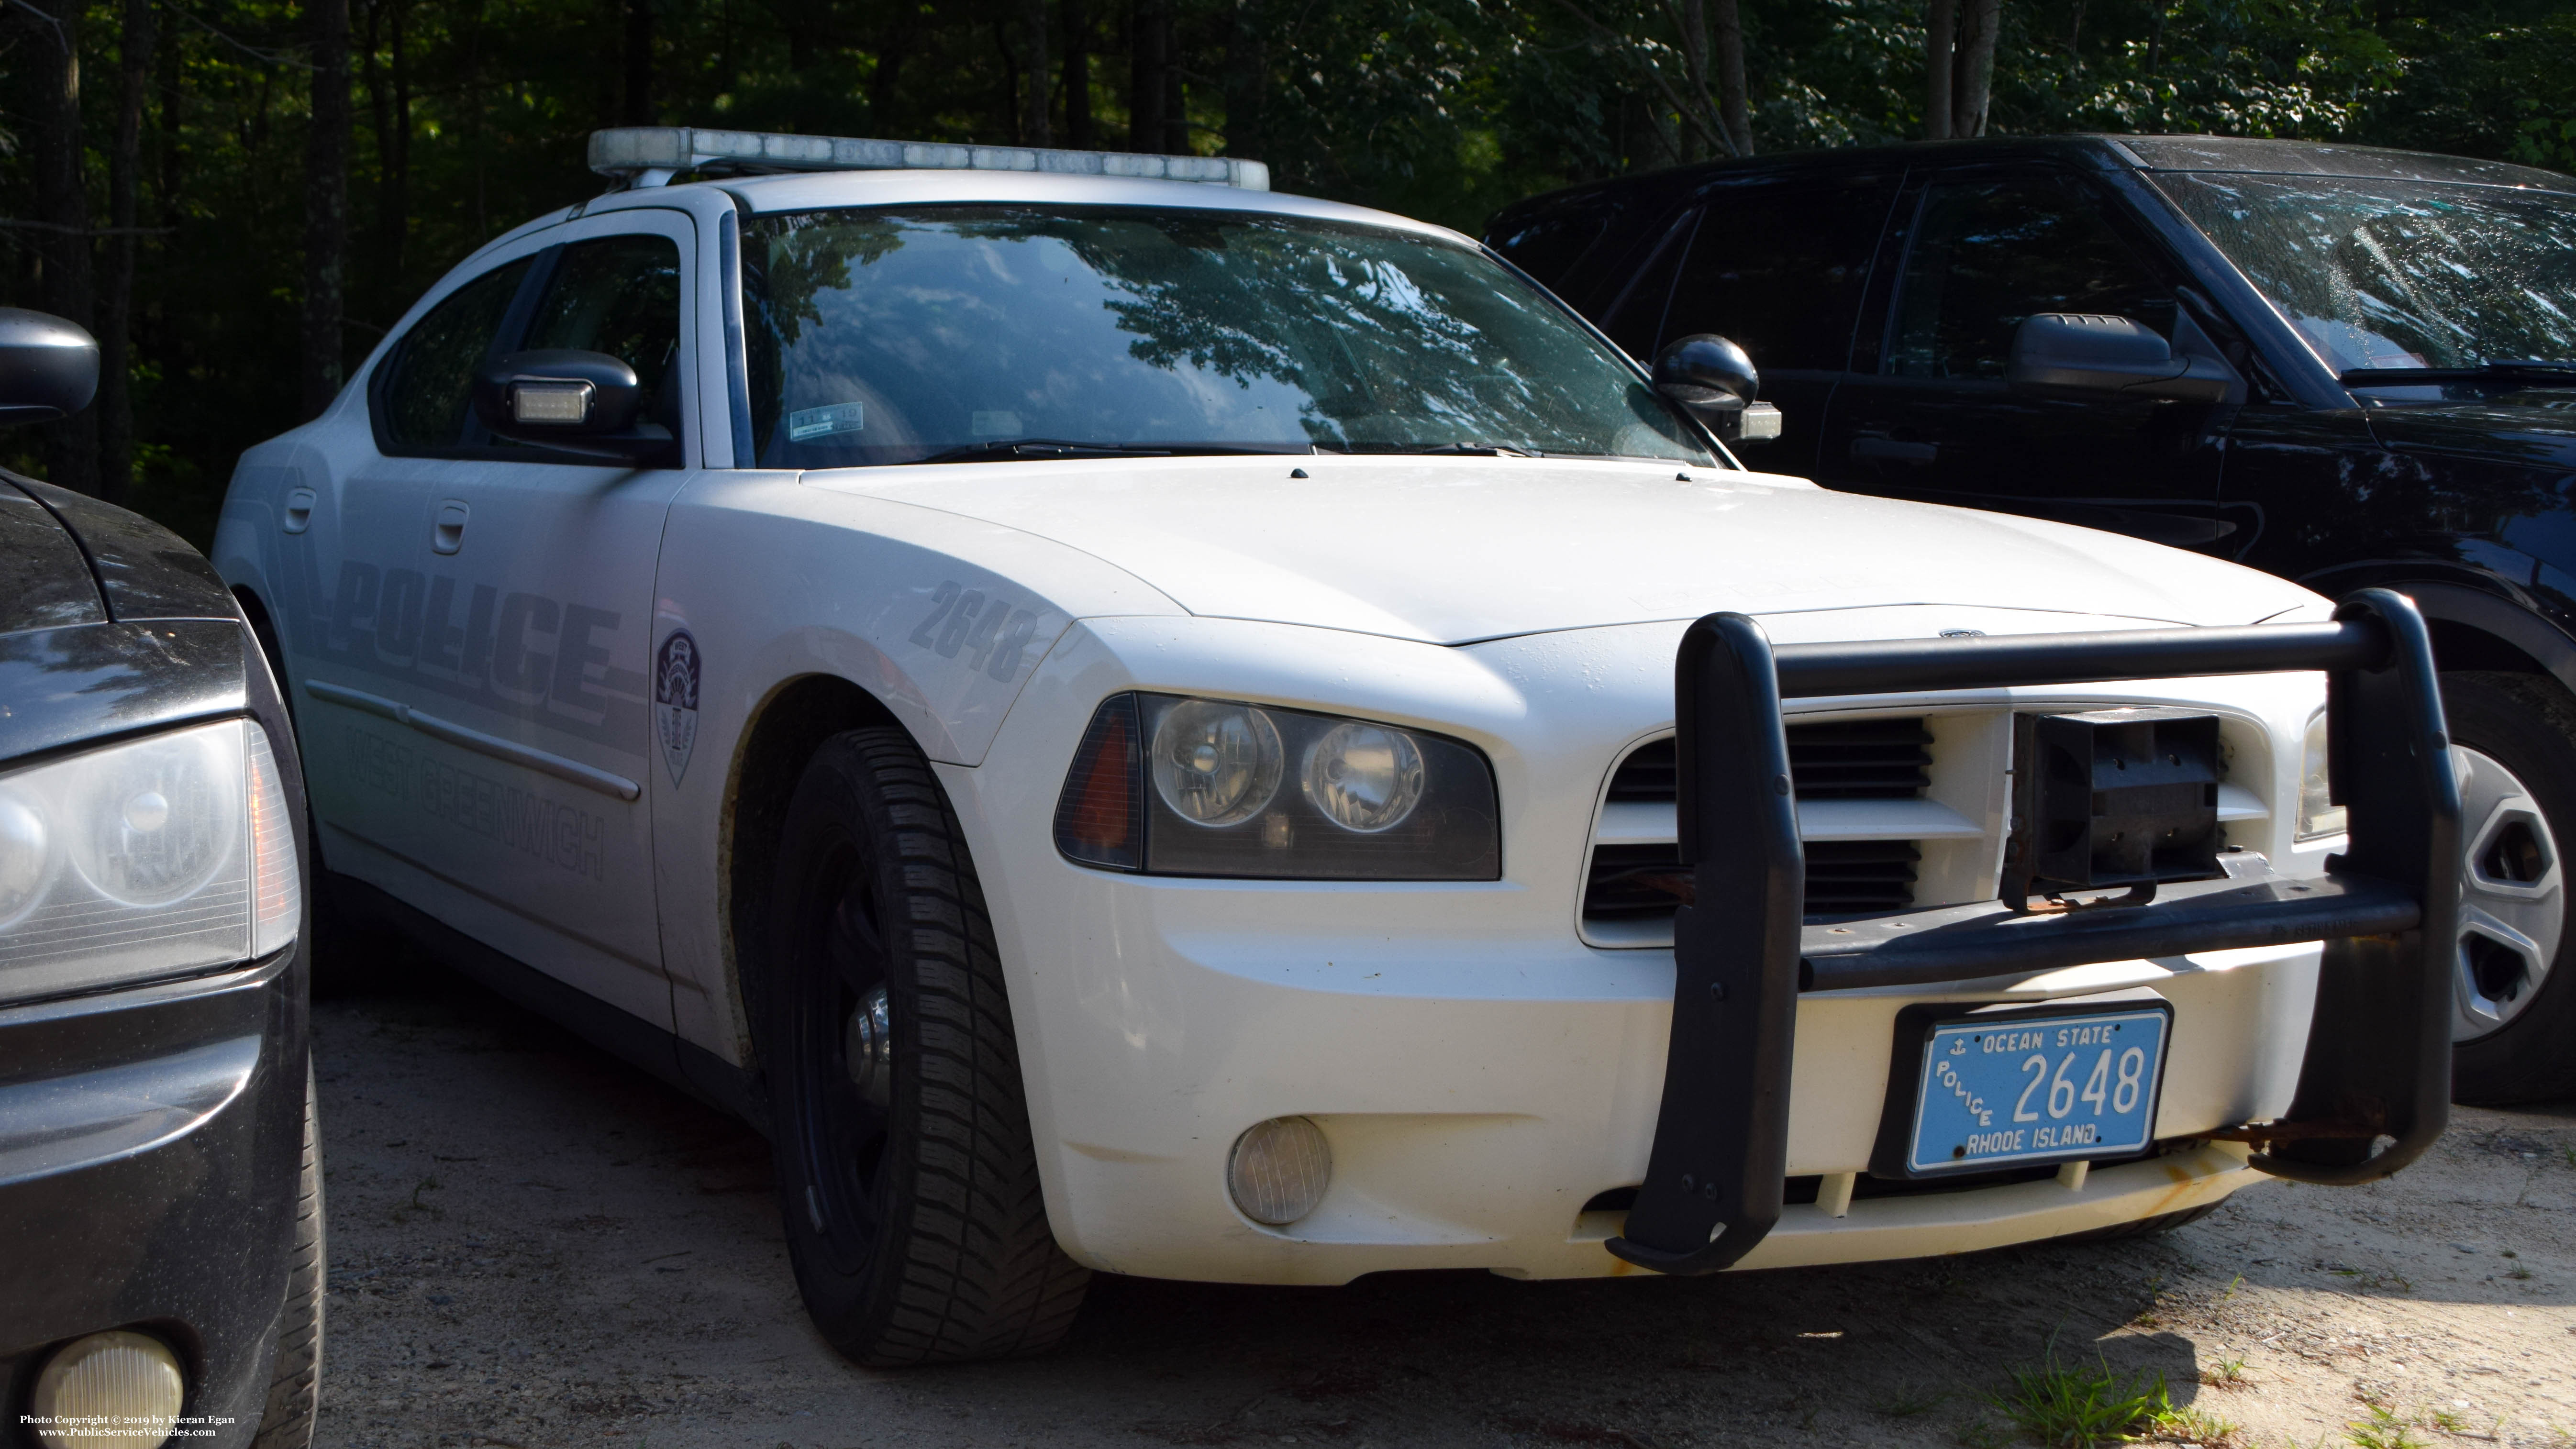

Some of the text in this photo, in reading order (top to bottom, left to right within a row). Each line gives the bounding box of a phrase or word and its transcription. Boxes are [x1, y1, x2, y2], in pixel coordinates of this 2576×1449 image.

[328, 560, 622, 726] POLICE
[674, 641, 688, 650] WEST
[909, 580, 1038, 683] 2648
[345, 725, 604, 882] WEST GREENWICH
[1983, 1025, 2112, 1053] OCEAN STATE
[1936, 1061, 1993, 1127] POLICE
[2013, 1046, 2144, 1122] 2648
[1966, 1123, 2096, 1154] RHODE ISLAND
